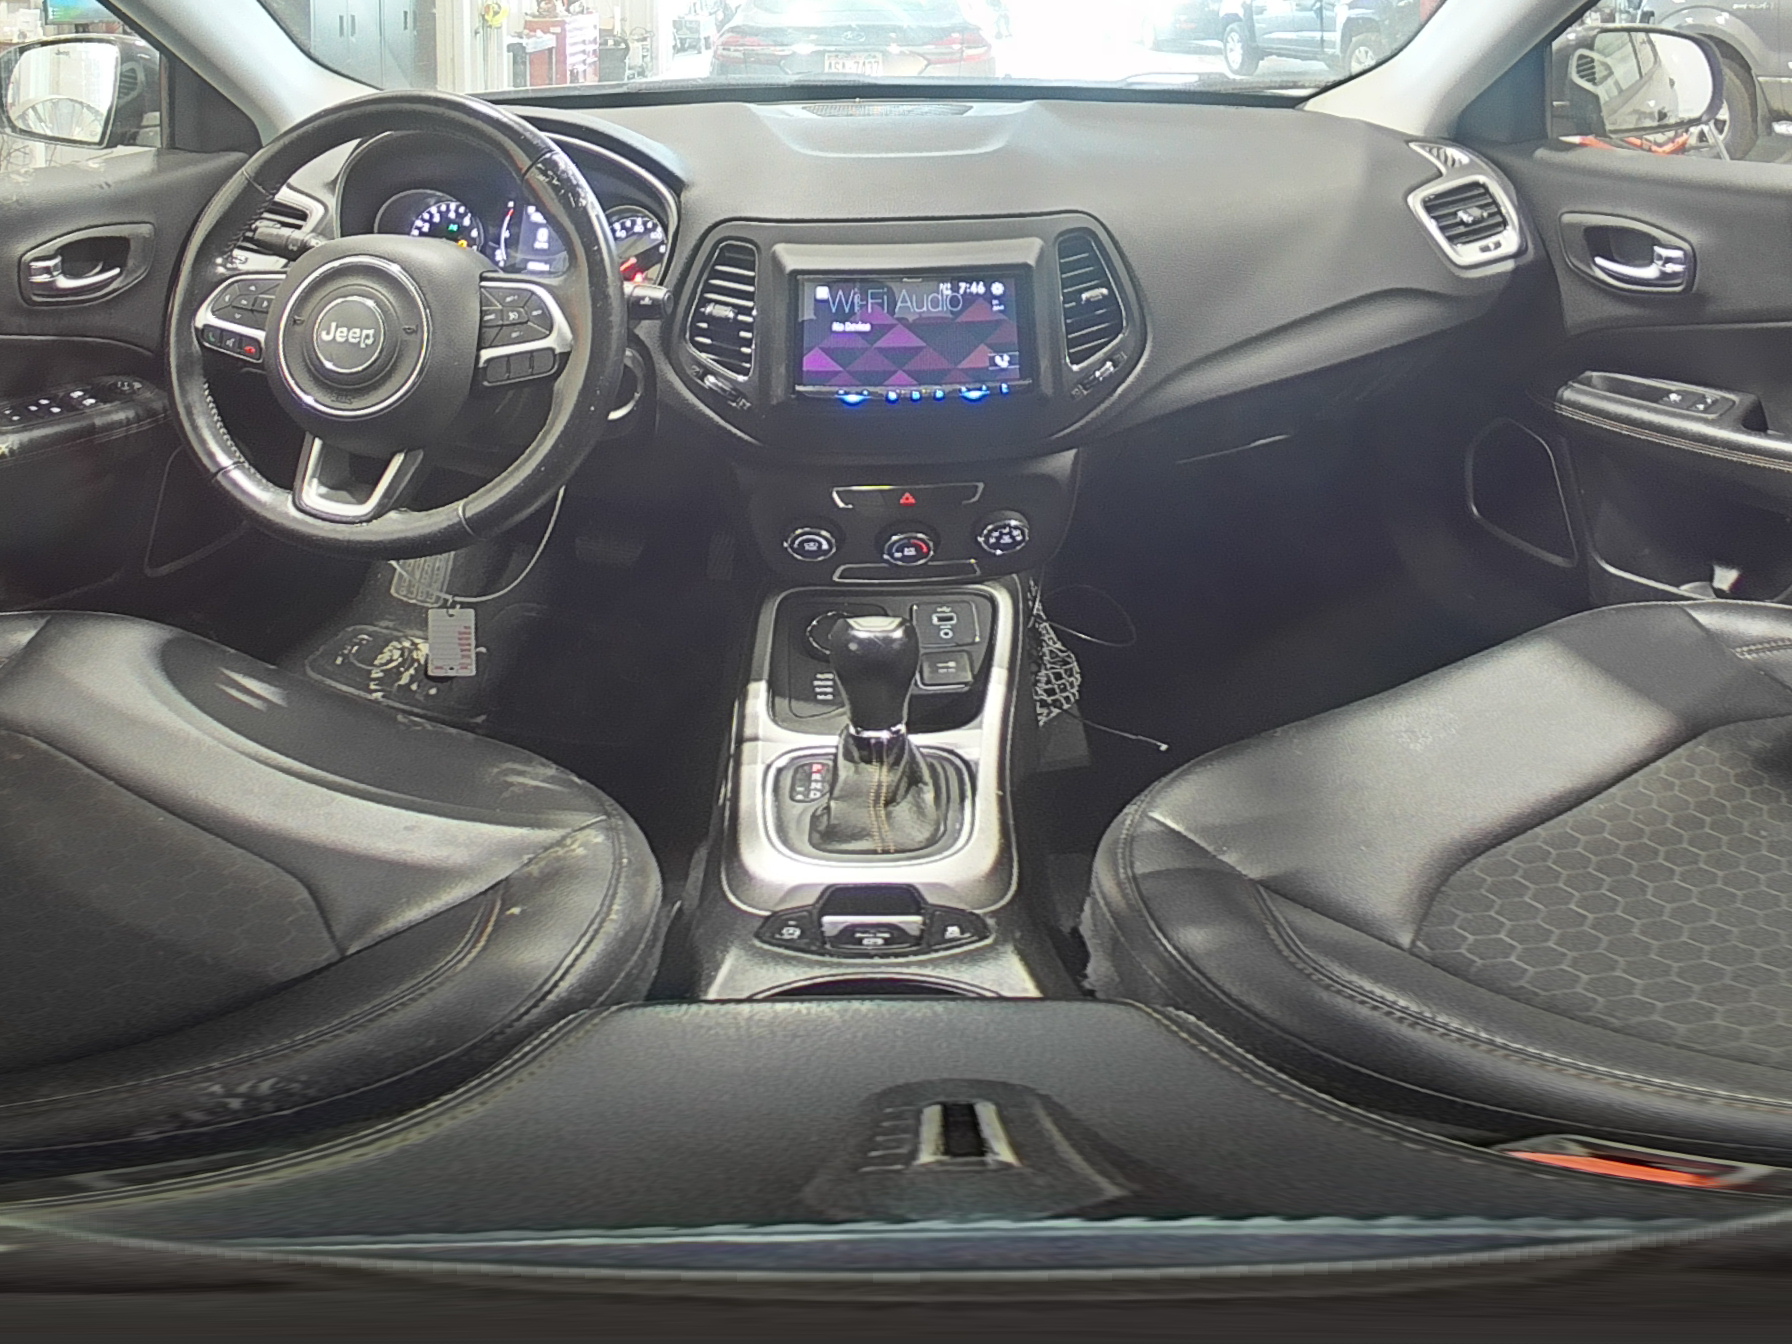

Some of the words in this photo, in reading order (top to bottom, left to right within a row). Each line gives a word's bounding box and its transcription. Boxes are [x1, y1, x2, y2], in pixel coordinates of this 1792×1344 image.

[828, 287, 888, 313] Wi-Fi
[895, 289, 963, 313] Audio
[958, 282, 985, 294] 7:46
[321, 322, 375, 348] Jeep
